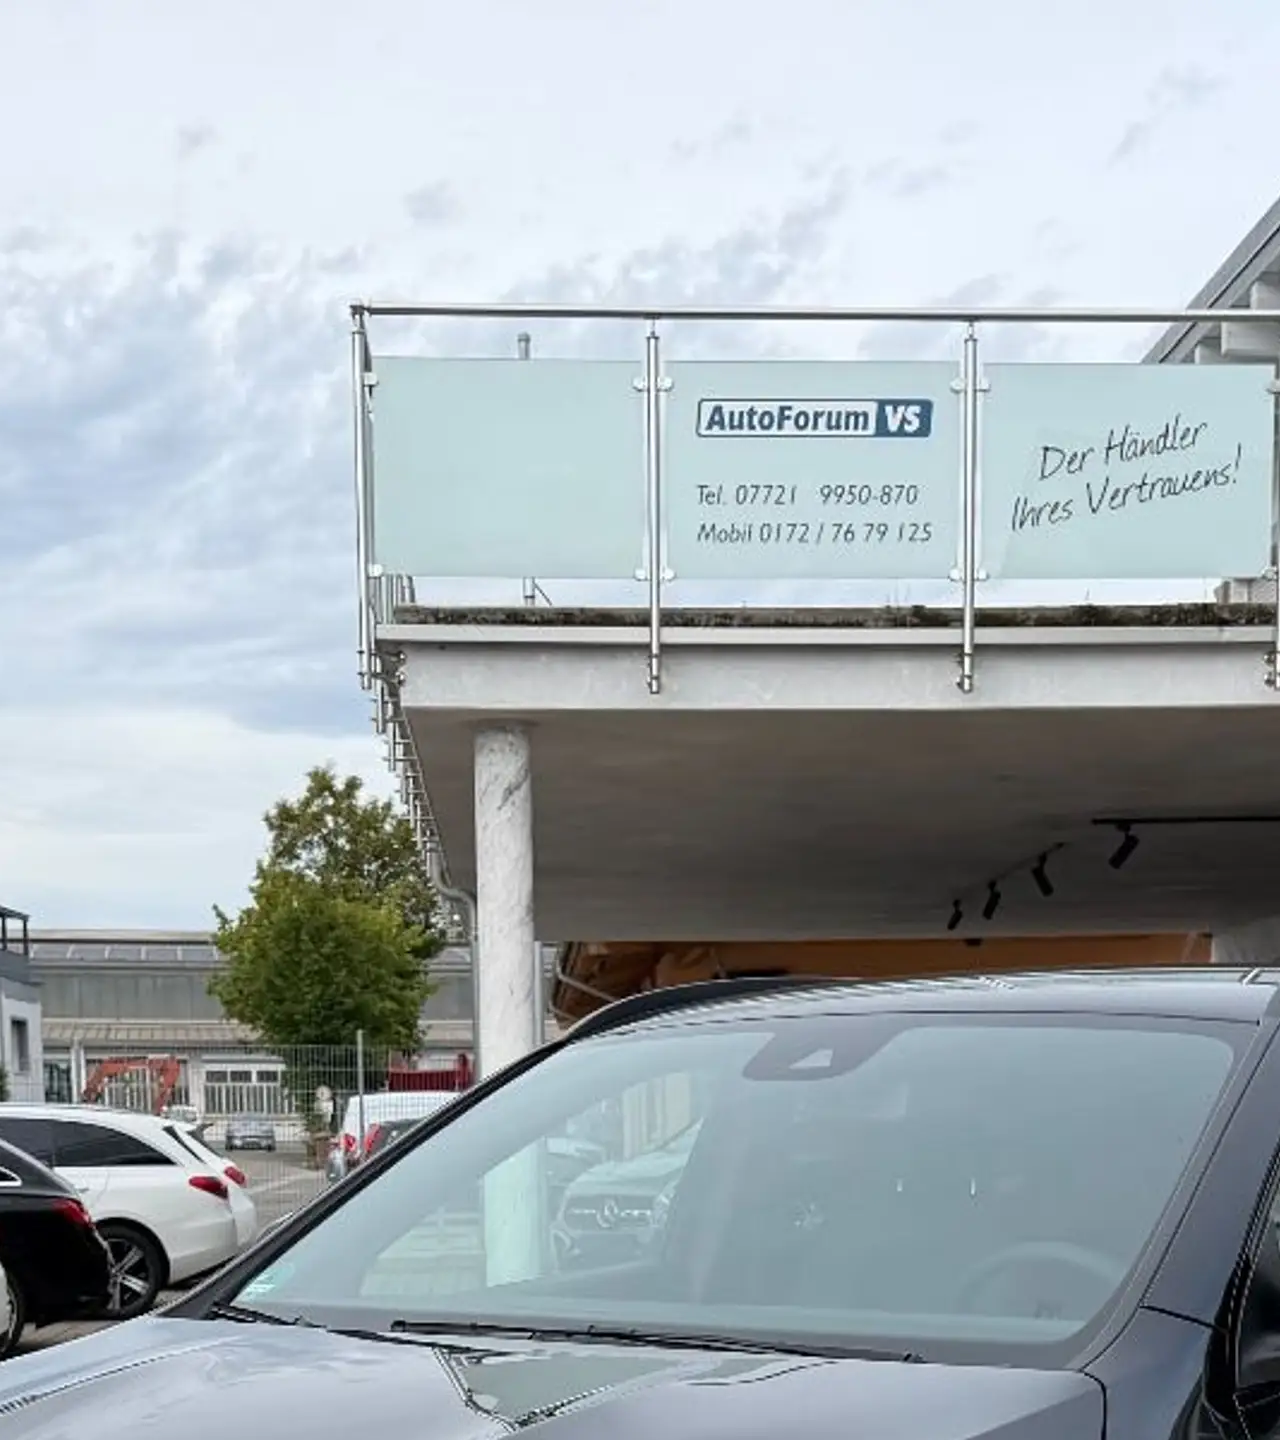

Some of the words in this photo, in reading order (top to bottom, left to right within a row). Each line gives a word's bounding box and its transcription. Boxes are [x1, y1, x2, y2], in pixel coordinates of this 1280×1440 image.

[705, 405, 870, 431] AutoForum
[884, 404, 922, 433] VS
[1038, 446, 1095, 481] Der
[1104, 413, 1208, 465] Händler
[697, 484, 726, 505] Tel.
[735, 484, 797, 505] 07721
[819, 484, 919, 505] 9950-870
[1012, 496, 1073, 531] Ihres
[1086, 442, 1242, 514] Vertrauens!
[697, 522, 752, 543] Mobil
[759, 522, 810, 544] 0172
[831, 522, 856, 543] 76
[863, 522, 889, 543] 79
[897, 522, 933, 543] 125
